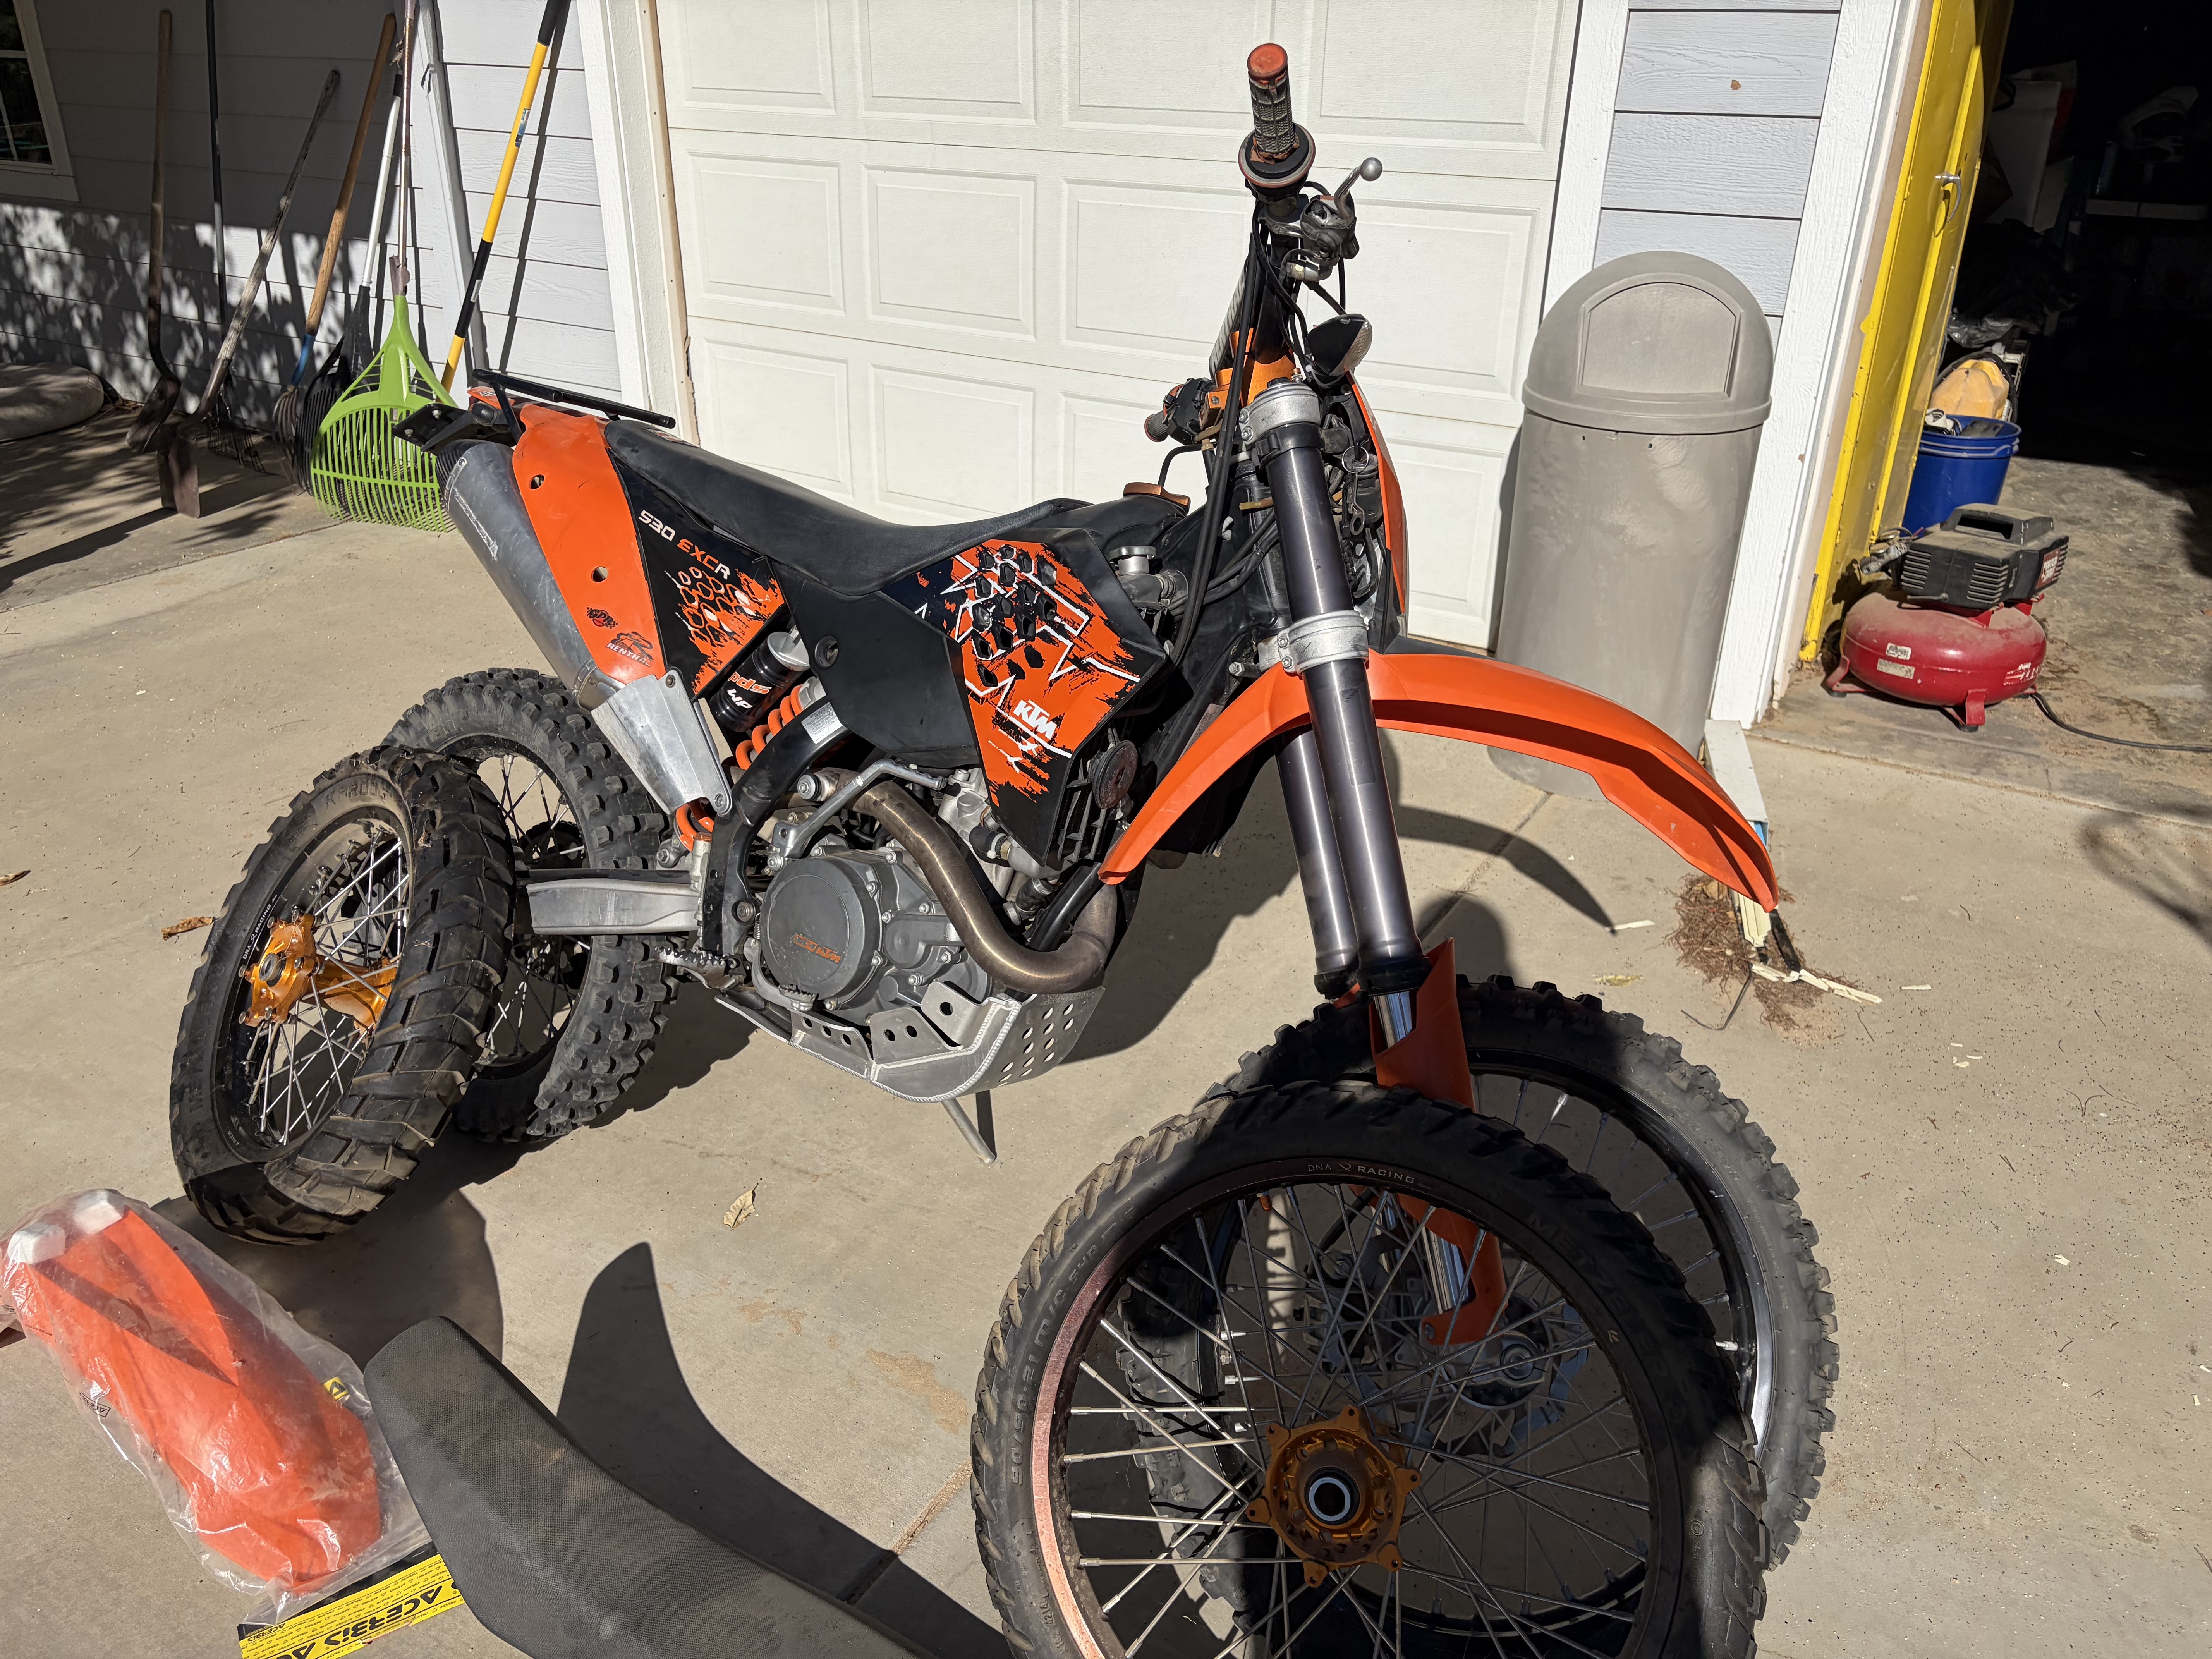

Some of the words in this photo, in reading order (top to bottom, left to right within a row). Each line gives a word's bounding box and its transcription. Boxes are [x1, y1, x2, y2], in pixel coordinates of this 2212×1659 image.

[639, 510, 675, 541] 530
[589, 609, 614, 625] GPR
[726, 689, 753, 709] WP
[1013, 699, 1058, 740] KTM
[242, 945, 252, 960] DNA
[255, 903, 272, 933] RACING
[1307, 1163, 1332, 1172] DNA
[1358, 1166, 1414, 1184] RACING
[325, 1585, 442, 1647] ACERBIS
[247, 1623, 285, 1642] ACERBIS
